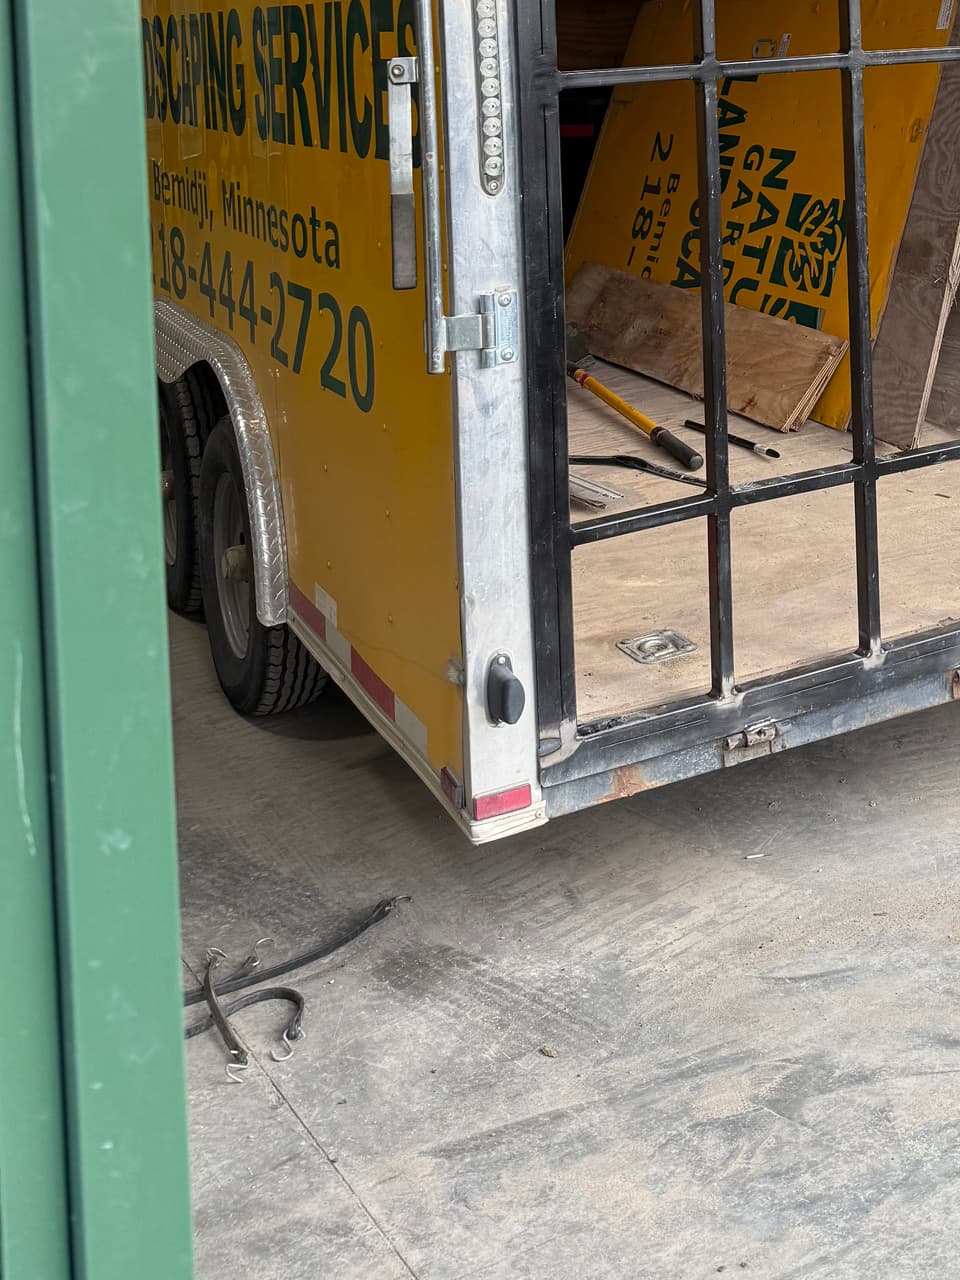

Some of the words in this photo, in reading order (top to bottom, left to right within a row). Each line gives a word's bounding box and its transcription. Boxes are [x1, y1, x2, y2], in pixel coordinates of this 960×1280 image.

[142, 8, 246, 136] DSCAPING
[153, 160, 213, 231] Bemidji,
[222, 180, 340, 269] Minnesota
[729, 148, 796, 305] NATU
[151, 223, 375, 413] 18-444-2720
